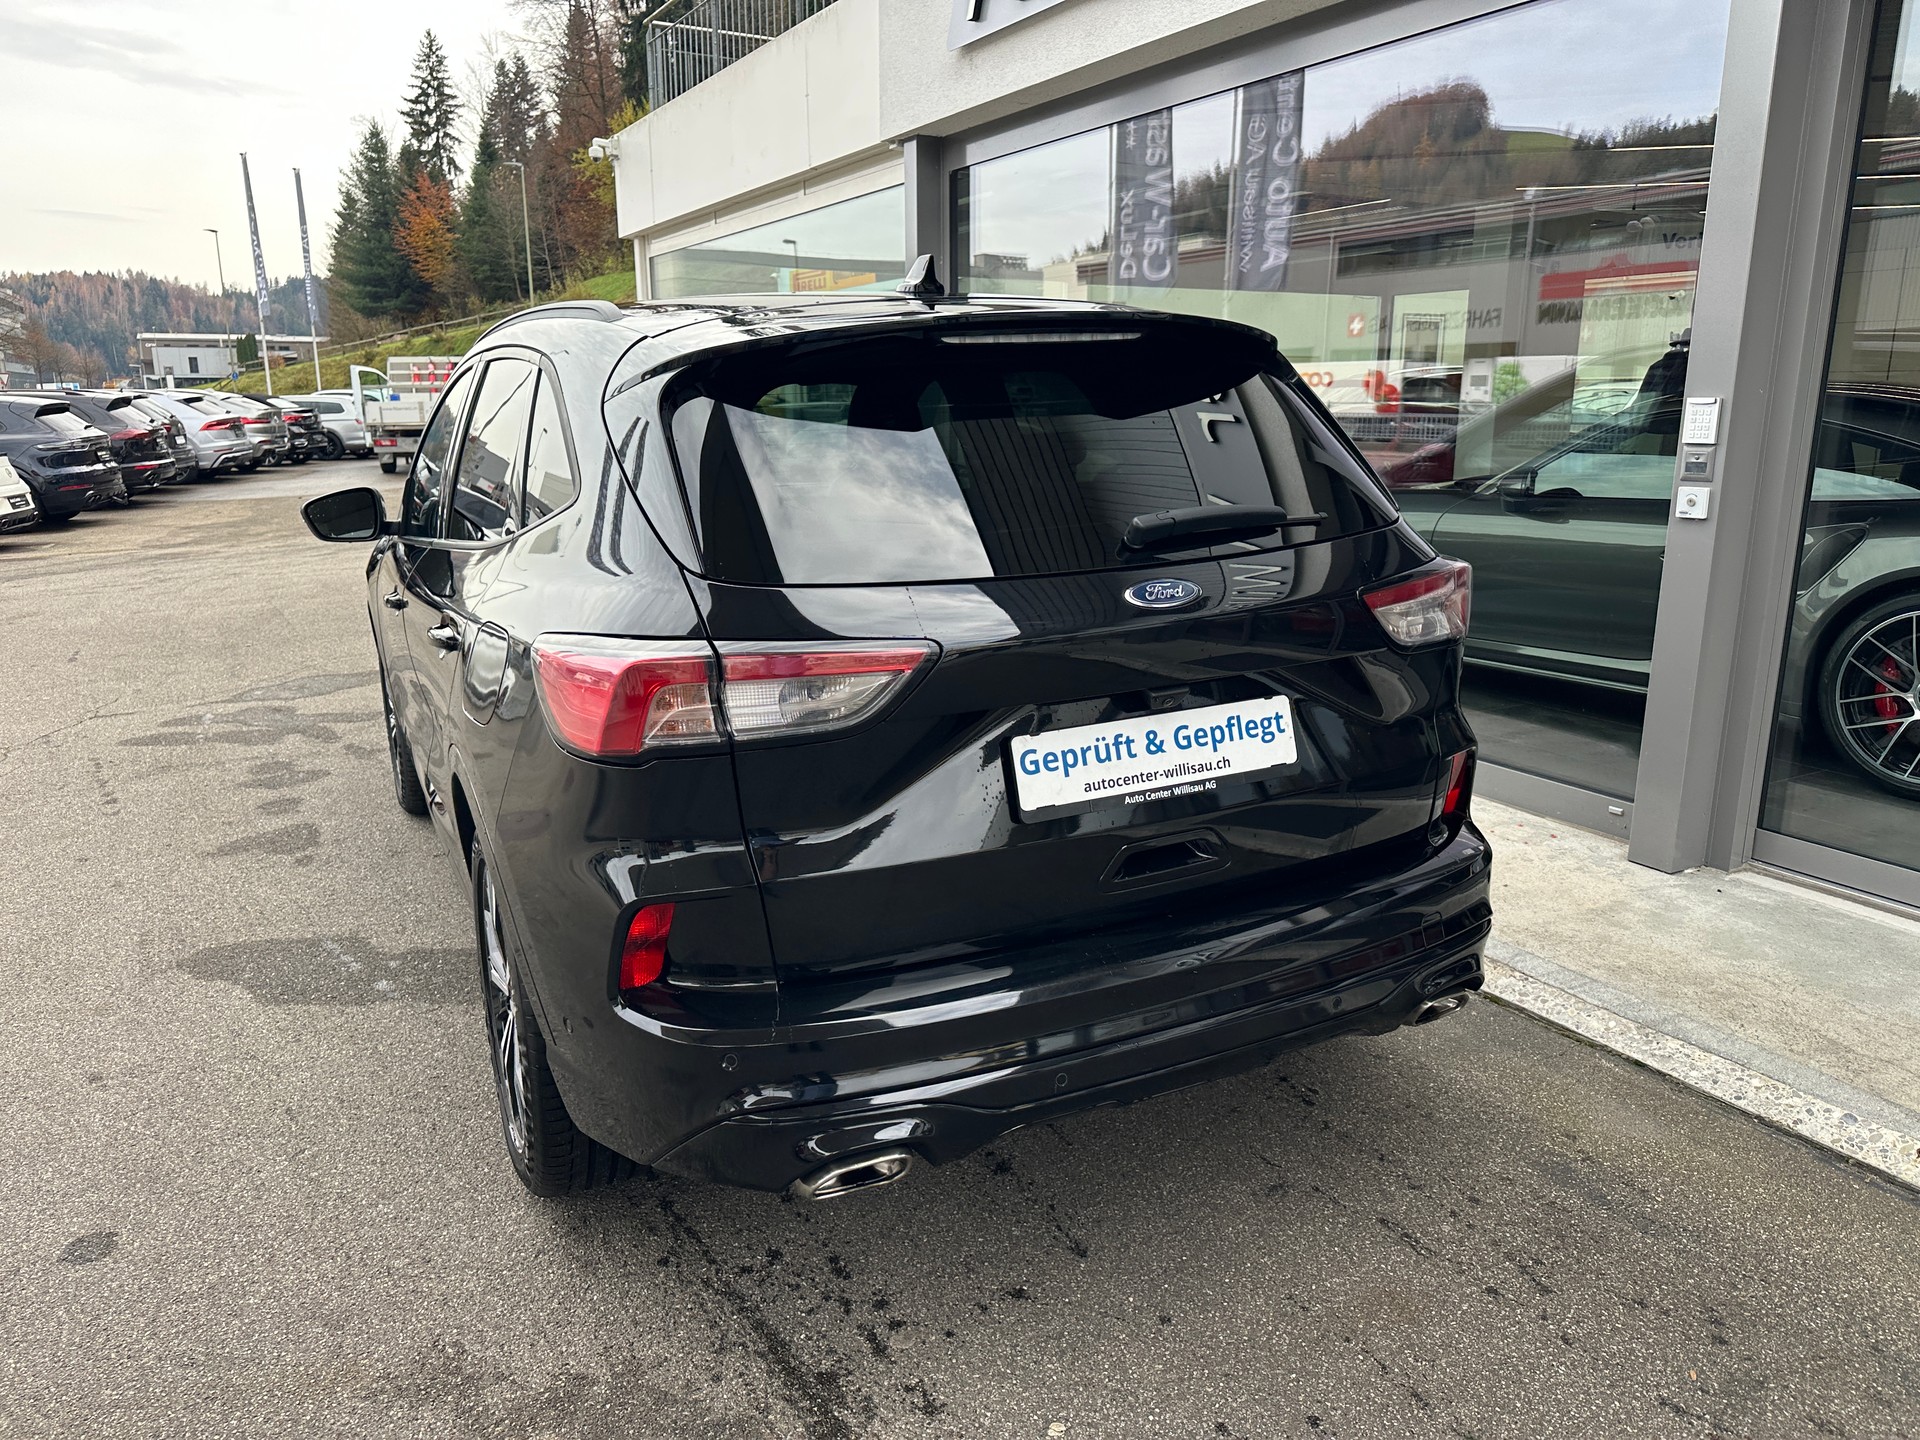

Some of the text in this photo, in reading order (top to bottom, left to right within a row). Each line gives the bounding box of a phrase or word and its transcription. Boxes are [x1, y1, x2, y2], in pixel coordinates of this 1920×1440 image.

[1146, 582, 1184, 600] Ford
[1019, 711, 1286, 777] Geprüft & Gepflegt
[1083, 756, 1231, 793] autocenter-willisau.ch
[1124, 780, 1217, 804] Auto Center Willisau AG
